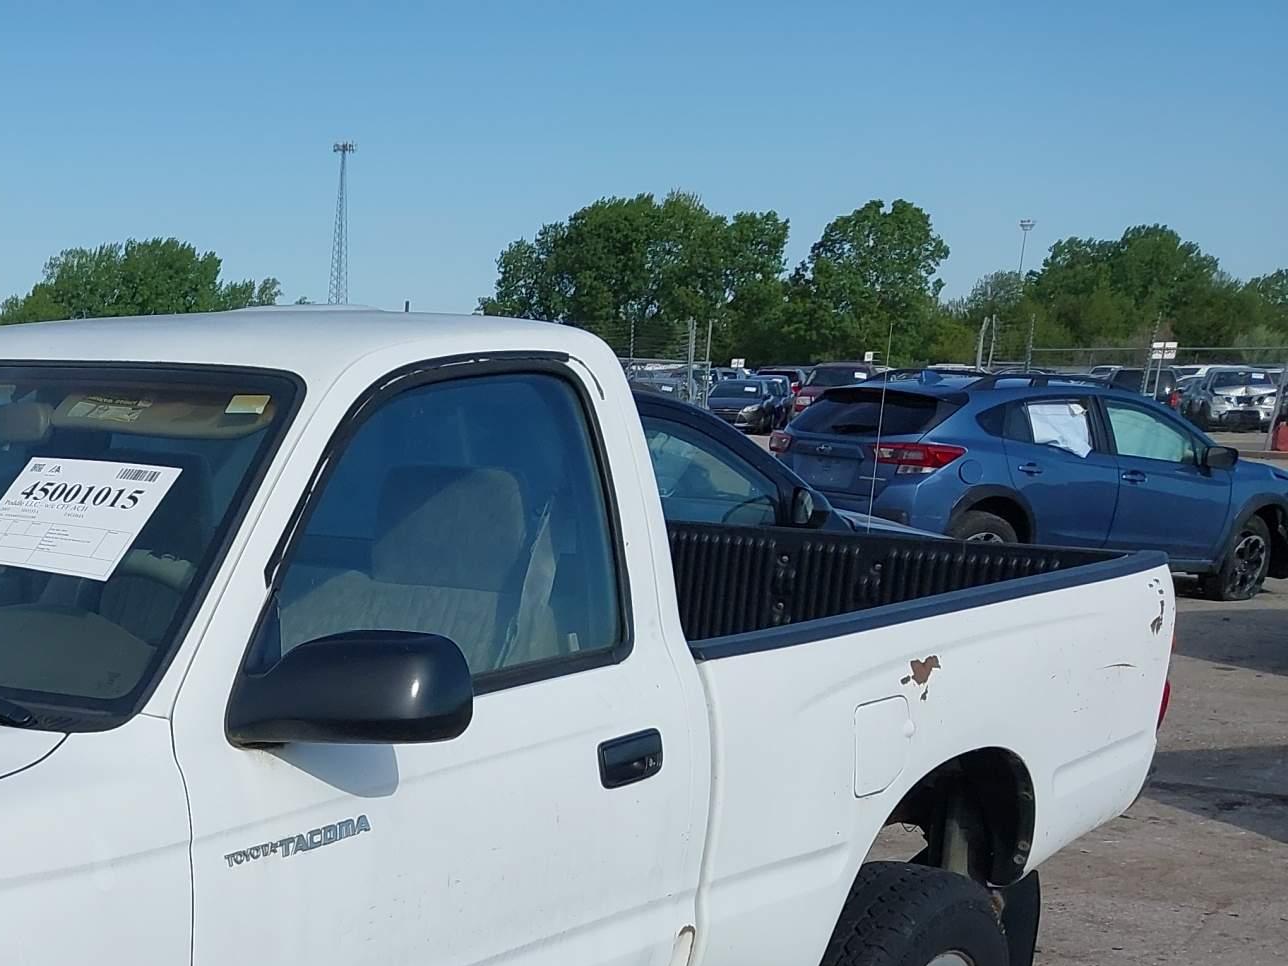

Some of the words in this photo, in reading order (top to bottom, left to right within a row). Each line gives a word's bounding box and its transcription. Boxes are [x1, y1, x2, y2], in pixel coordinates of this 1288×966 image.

[21, 481, 145, 510] 45001015
[224, 841, 278, 867] TOYOTA
[279, 814, 371, 858] TACOMA
